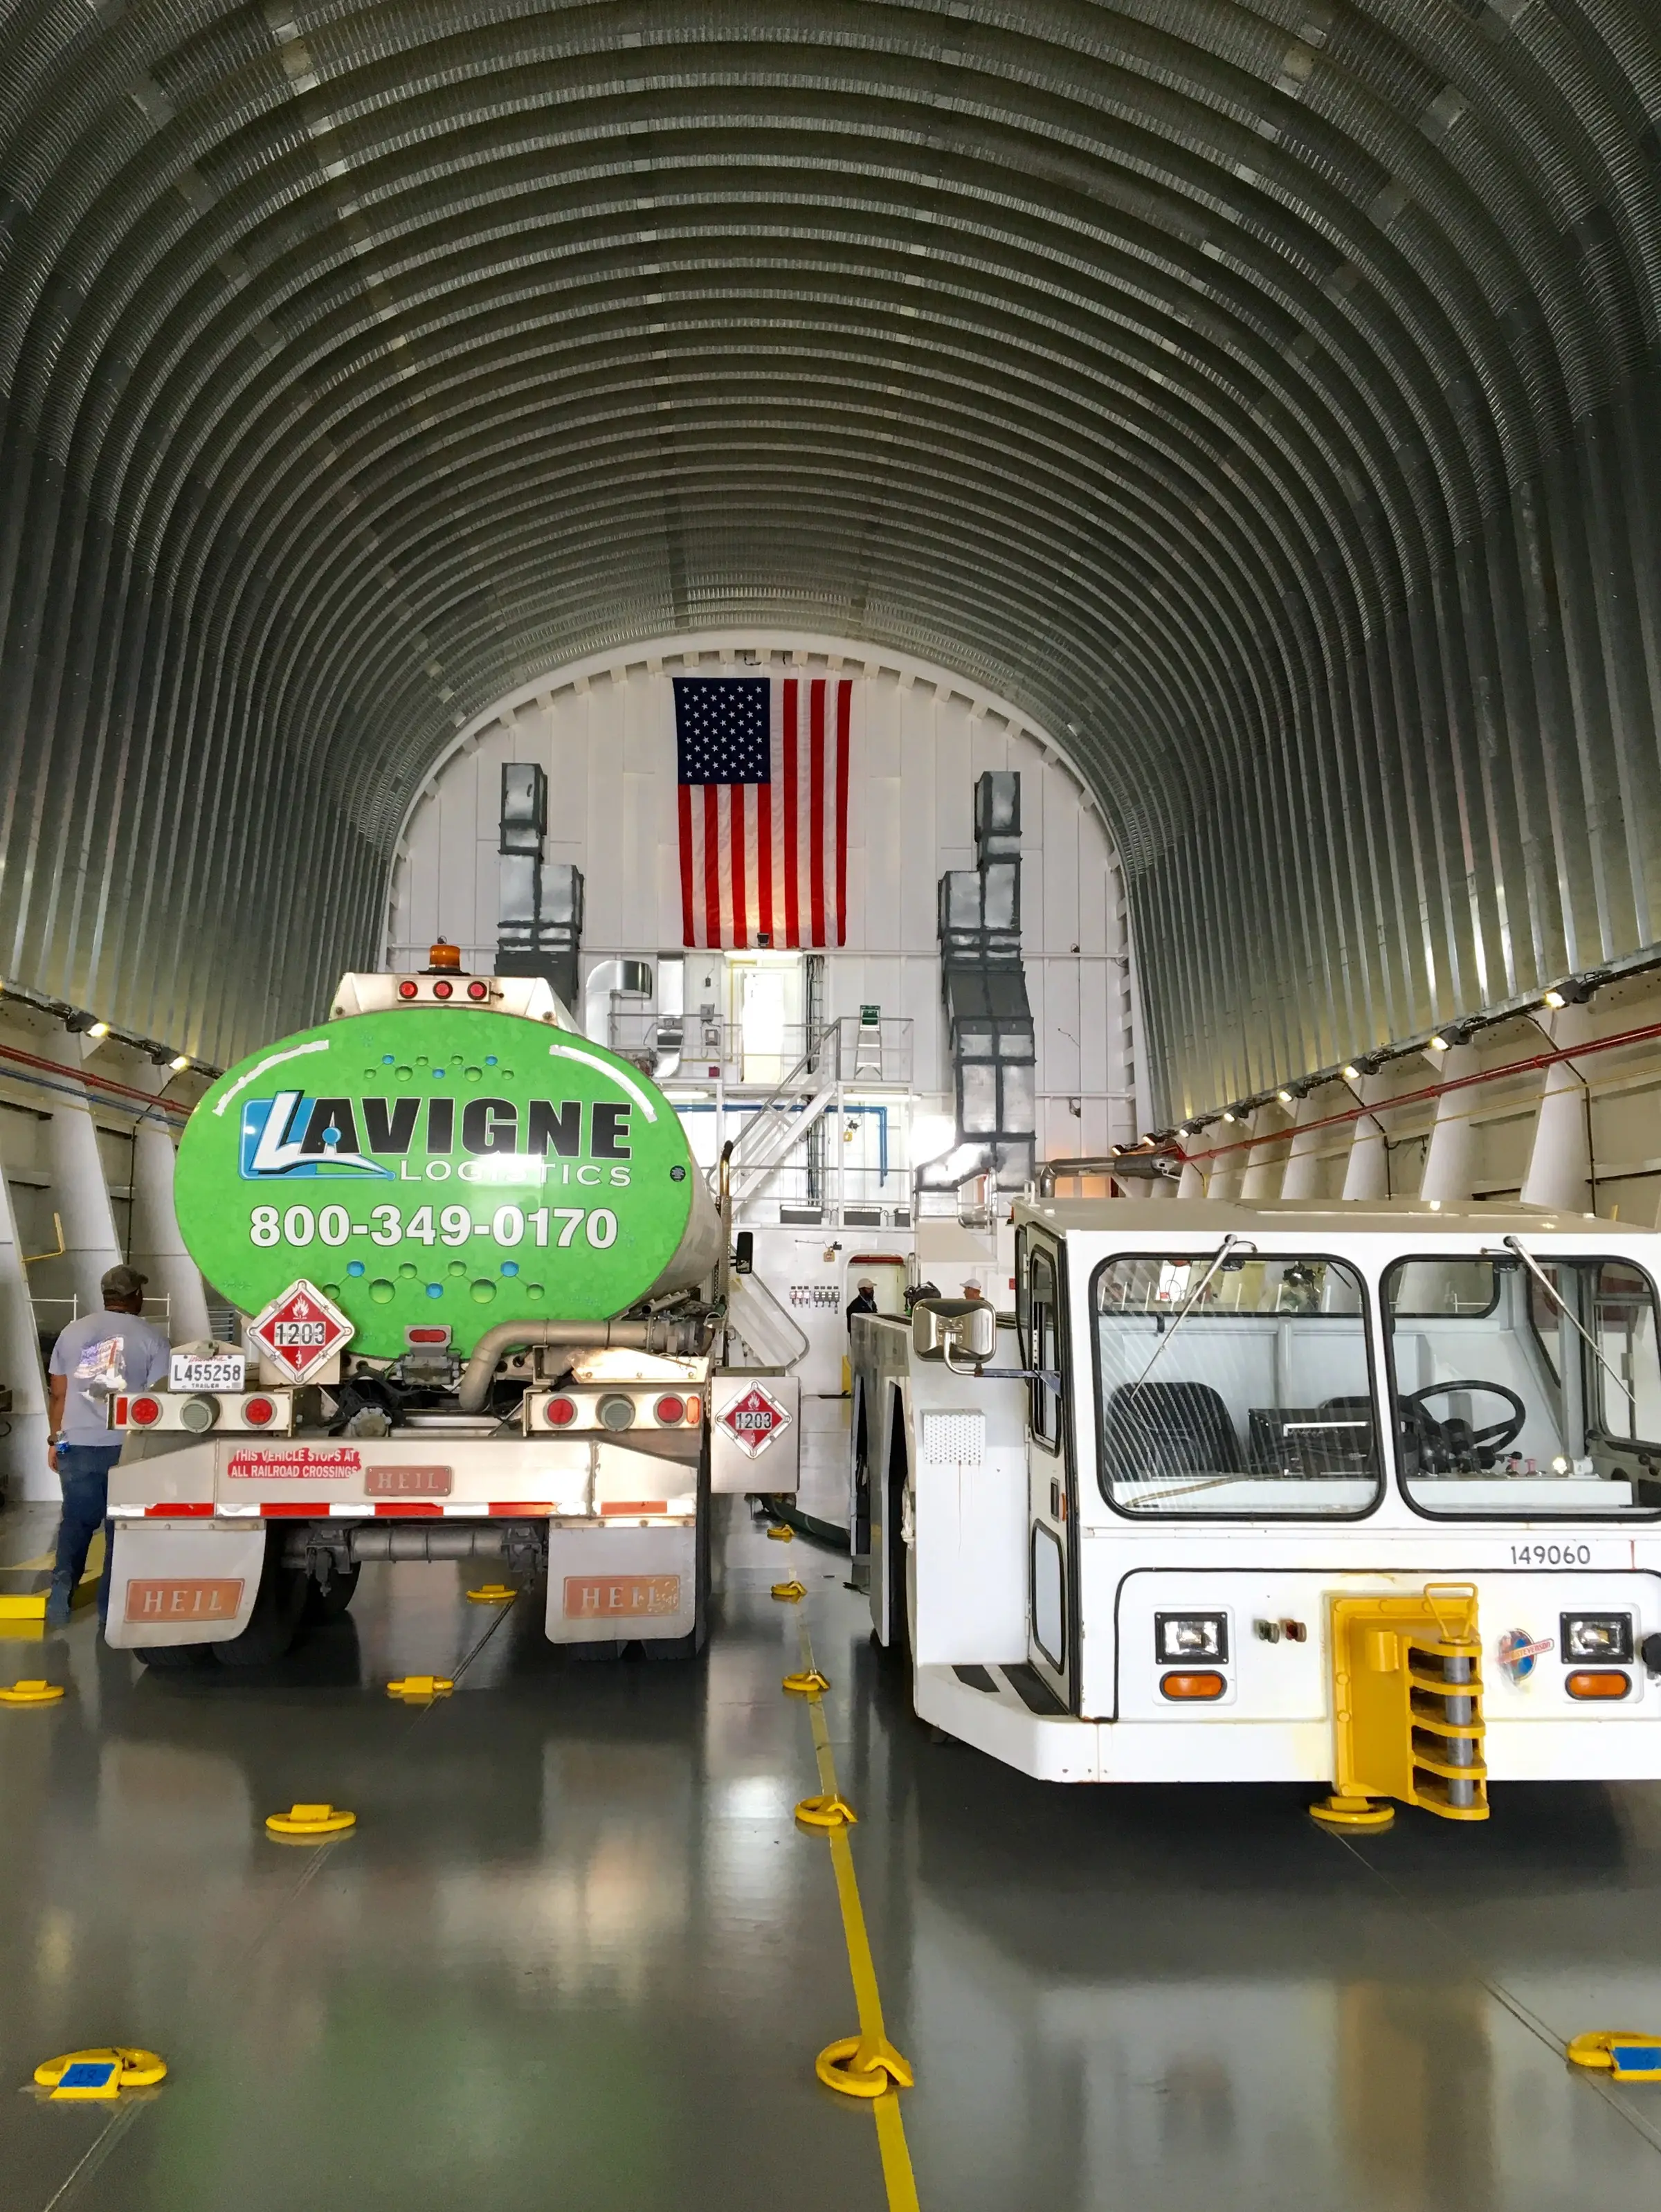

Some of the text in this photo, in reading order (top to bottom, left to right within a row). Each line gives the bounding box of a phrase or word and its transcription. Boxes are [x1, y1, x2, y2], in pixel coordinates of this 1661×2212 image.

[251, 1091, 633, 1173] LAVIGNE
[399, 1159, 631, 1187] LOGISTICS
[249, 1204, 618, 1249] 800-349-0170
[277, 1323, 325, 1345] 1203
[296, 1354, 302, 1365] 3
[174, 1364, 241, 1381] L455258
[736, 1413, 772, 1429] 1203
[236, 1449, 355, 1462] THIS VEHICLE STOPS AT
[231, 1465, 358, 1477] ALL RAILROAD CROSSINGS
[377, 1473, 439, 1489] HEIL
[1511, 1545, 1590, 1564] 149060
[143, 1590, 222, 1613] HEIL
[581, 1586, 661, 1609] HEIL
